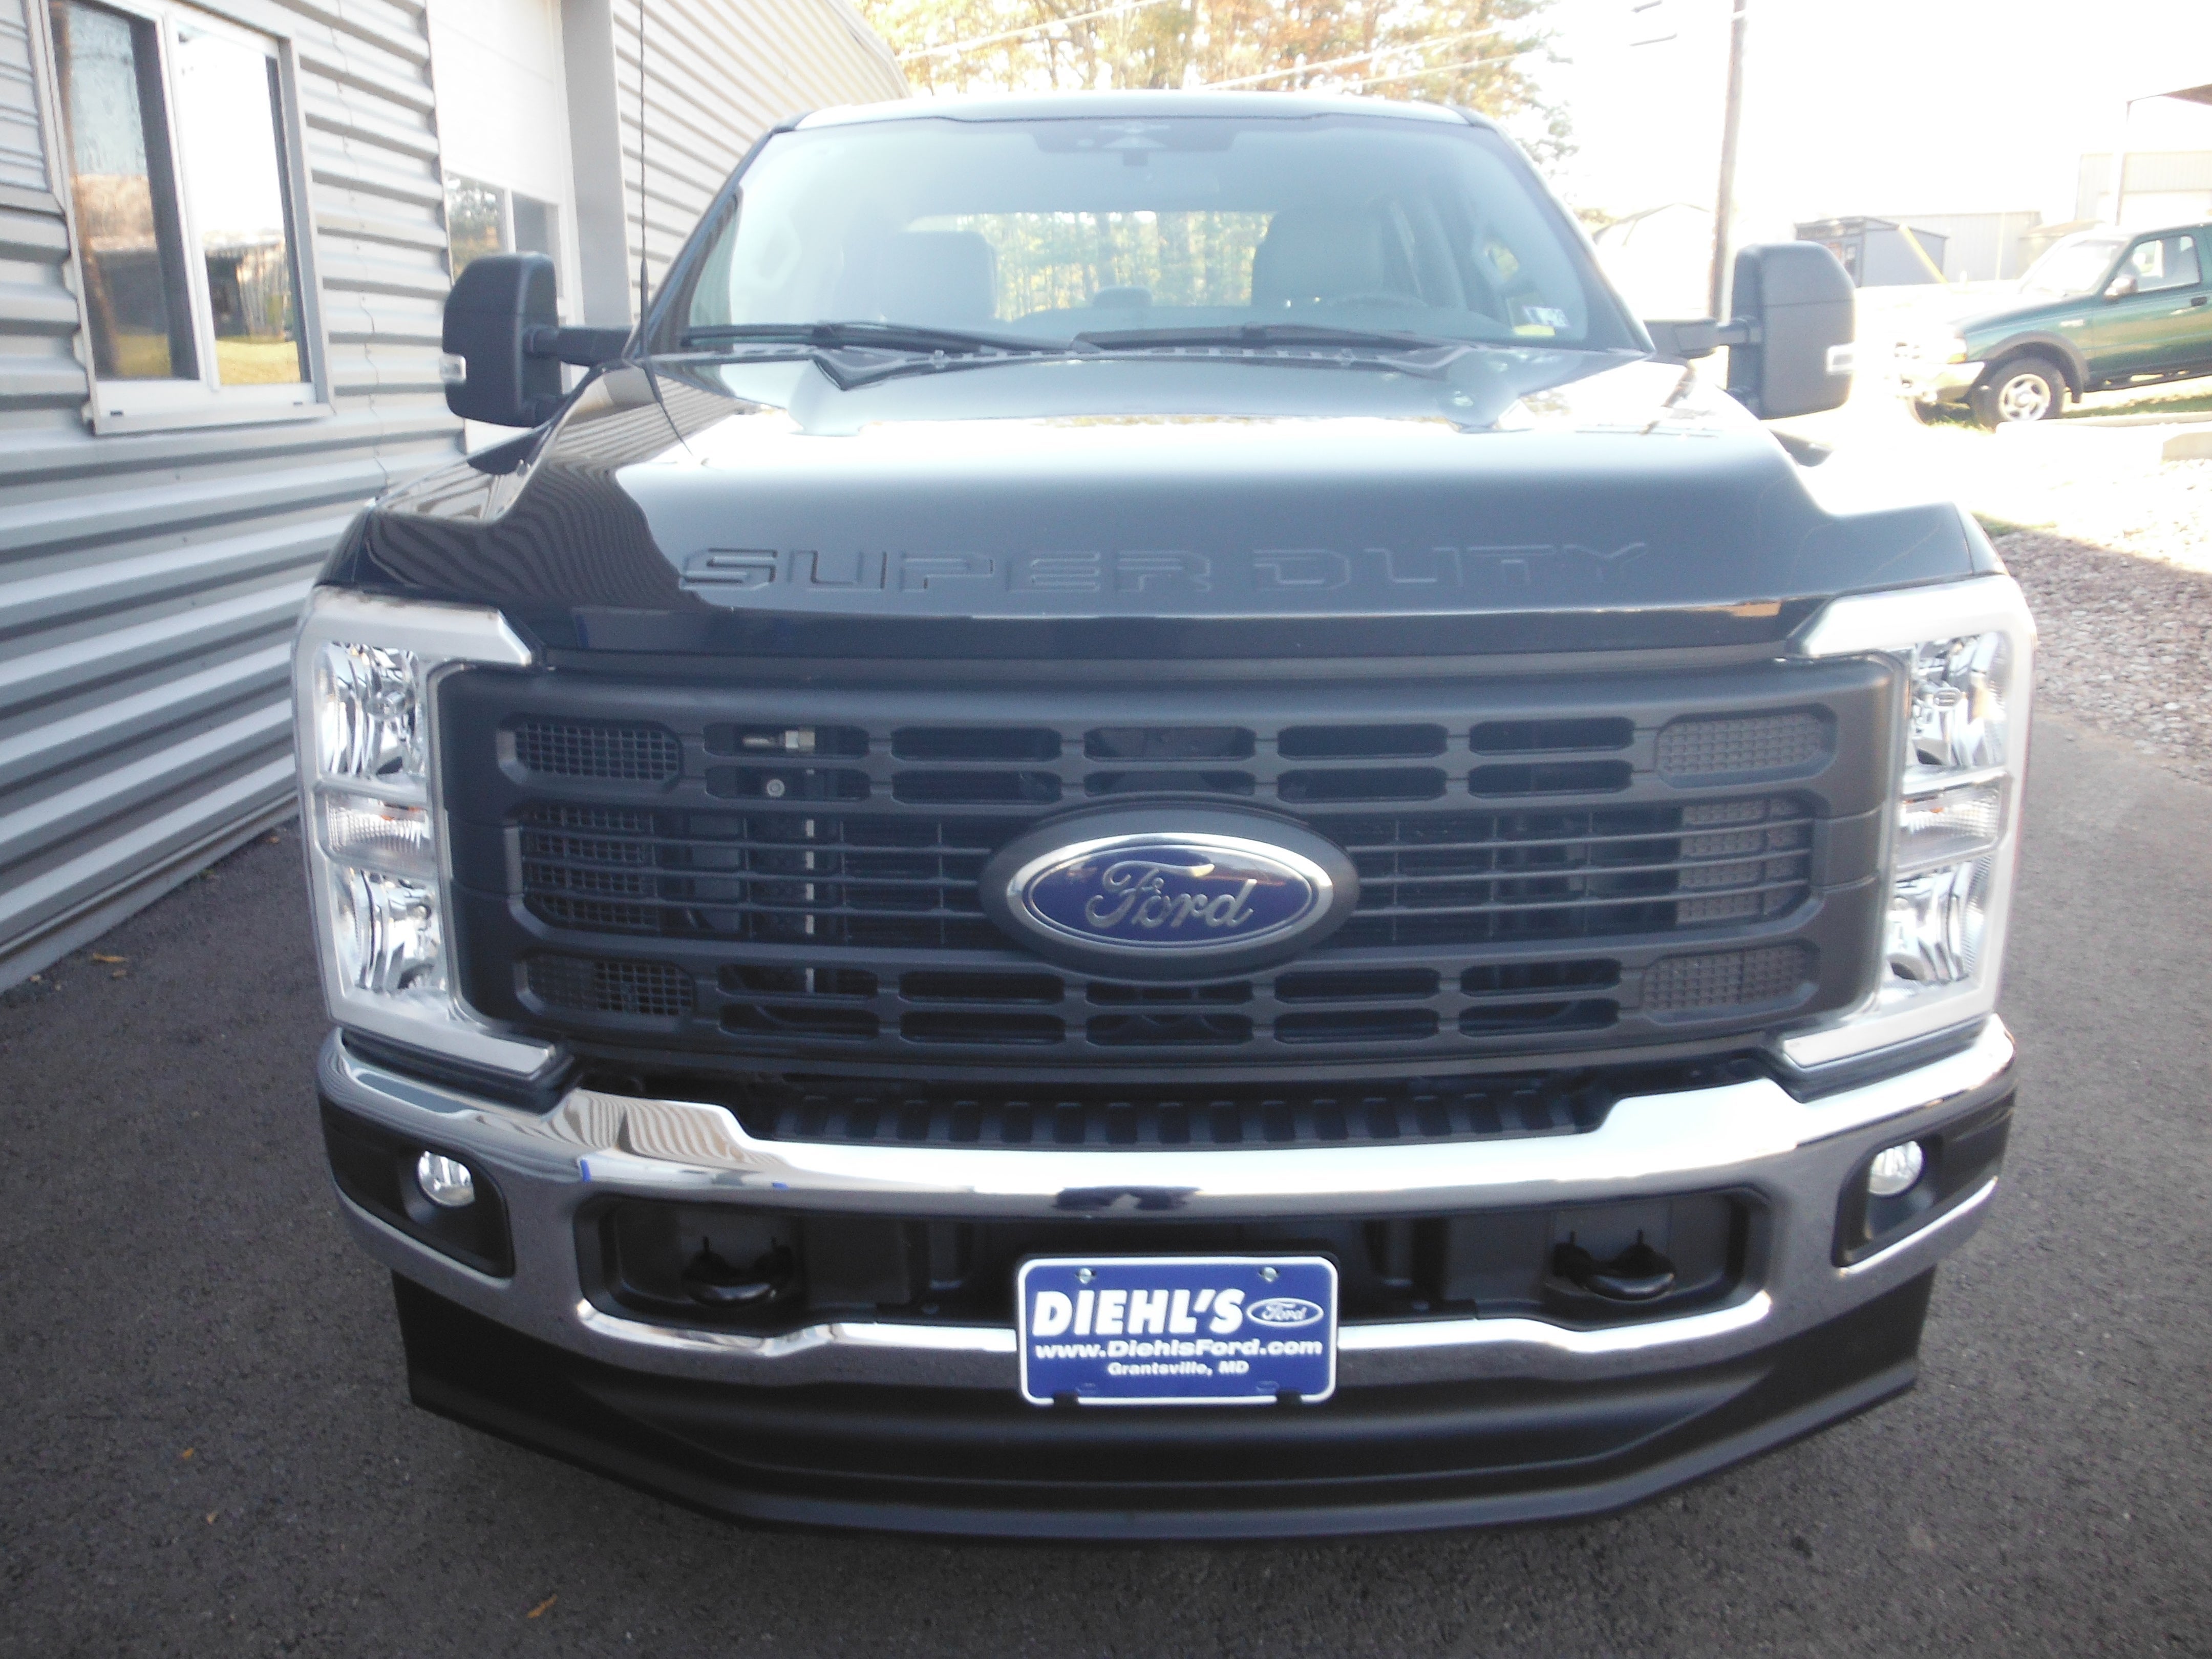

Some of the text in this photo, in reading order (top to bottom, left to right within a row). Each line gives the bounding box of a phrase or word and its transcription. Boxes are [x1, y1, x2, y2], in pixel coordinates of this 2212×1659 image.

[679, 542, 1647, 593] SUPER DUTY
[1085, 860, 1258, 928] Ford
[1032, 1288, 1246, 1336] DIEHL'S
[1262, 1300, 1308, 1321] Ford
[1035, 1338, 1323, 1358] www.DiehlsFord.com
[1107, 1360, 1249, 1376] Grantsville, MD
